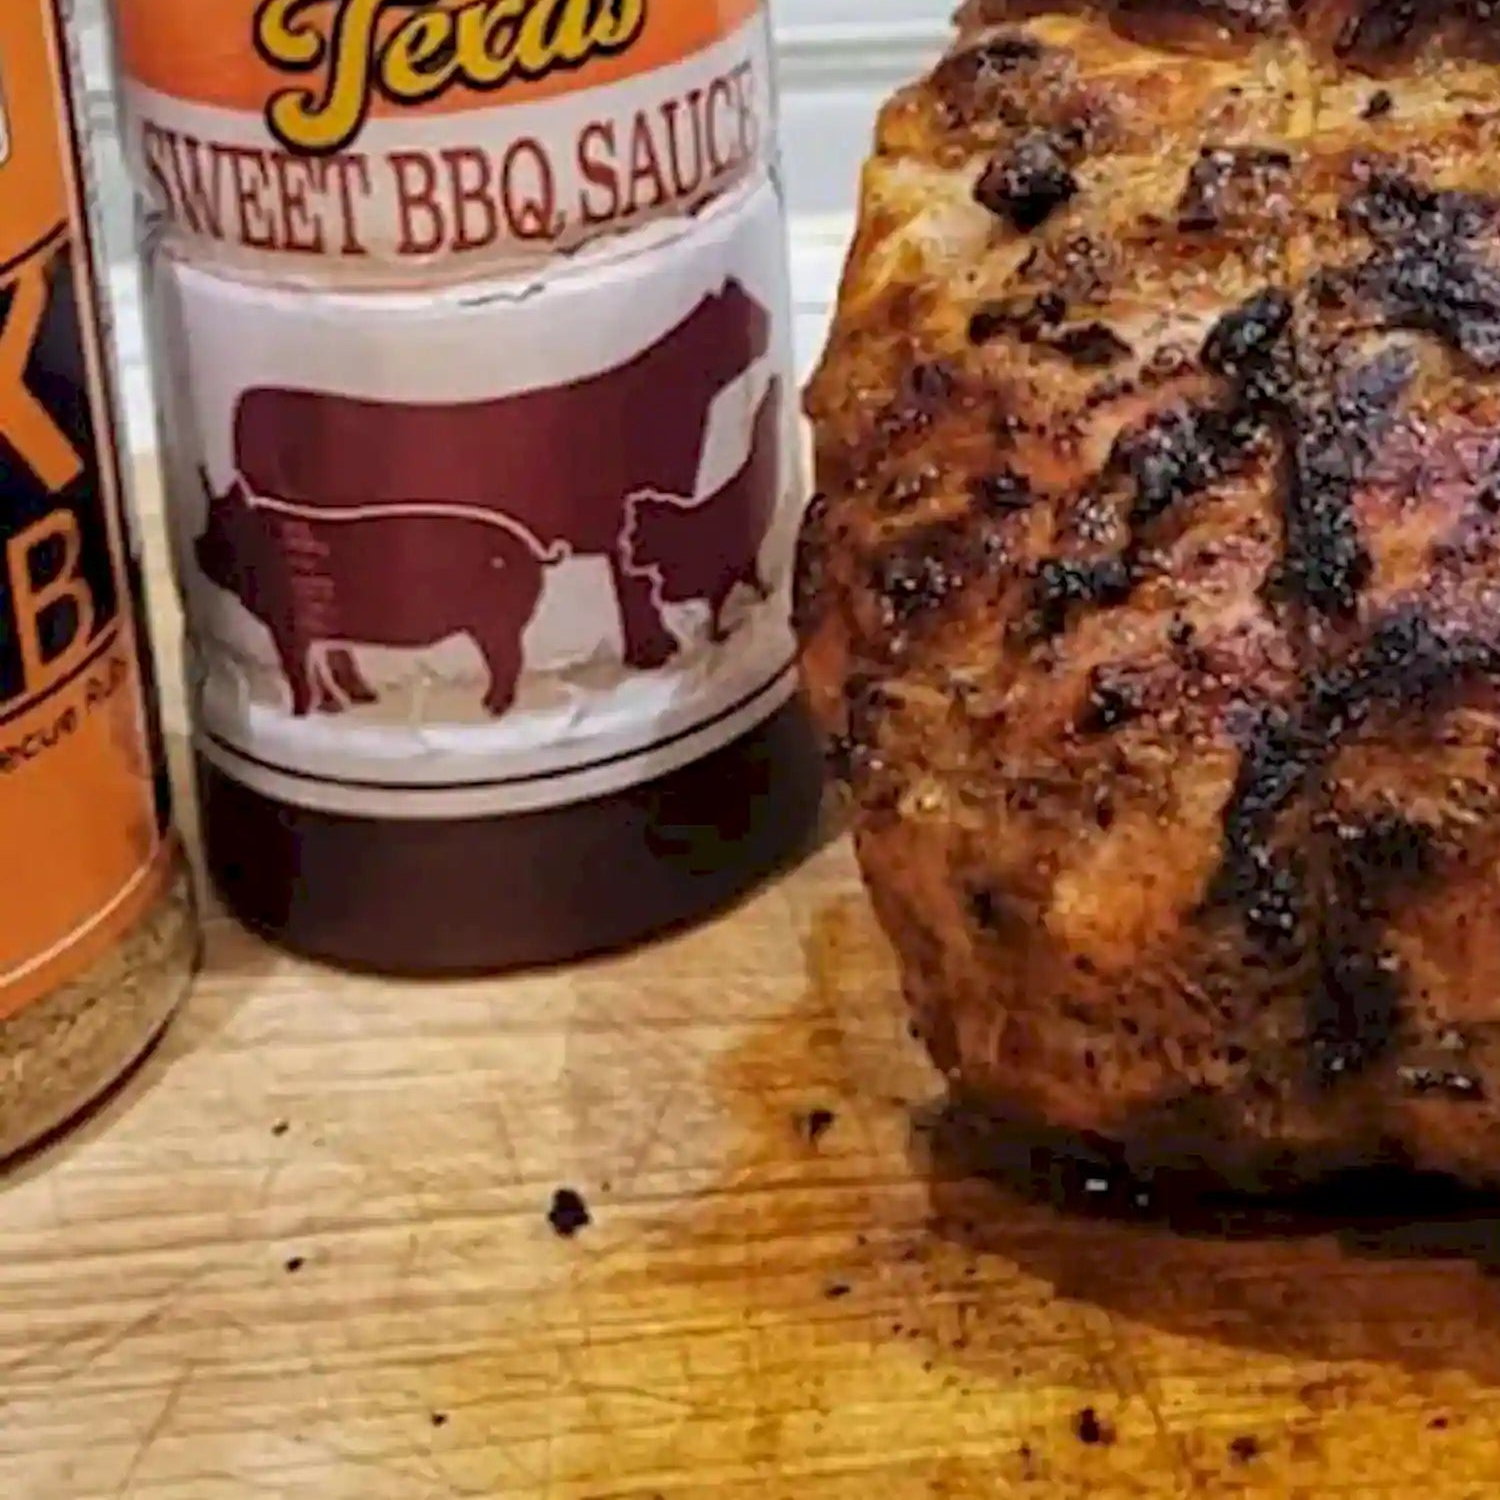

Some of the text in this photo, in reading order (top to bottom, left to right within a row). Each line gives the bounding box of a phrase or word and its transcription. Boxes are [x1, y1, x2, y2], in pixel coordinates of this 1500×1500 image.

[142, 58, 760, 256] SWEET BBQ SAUCE
